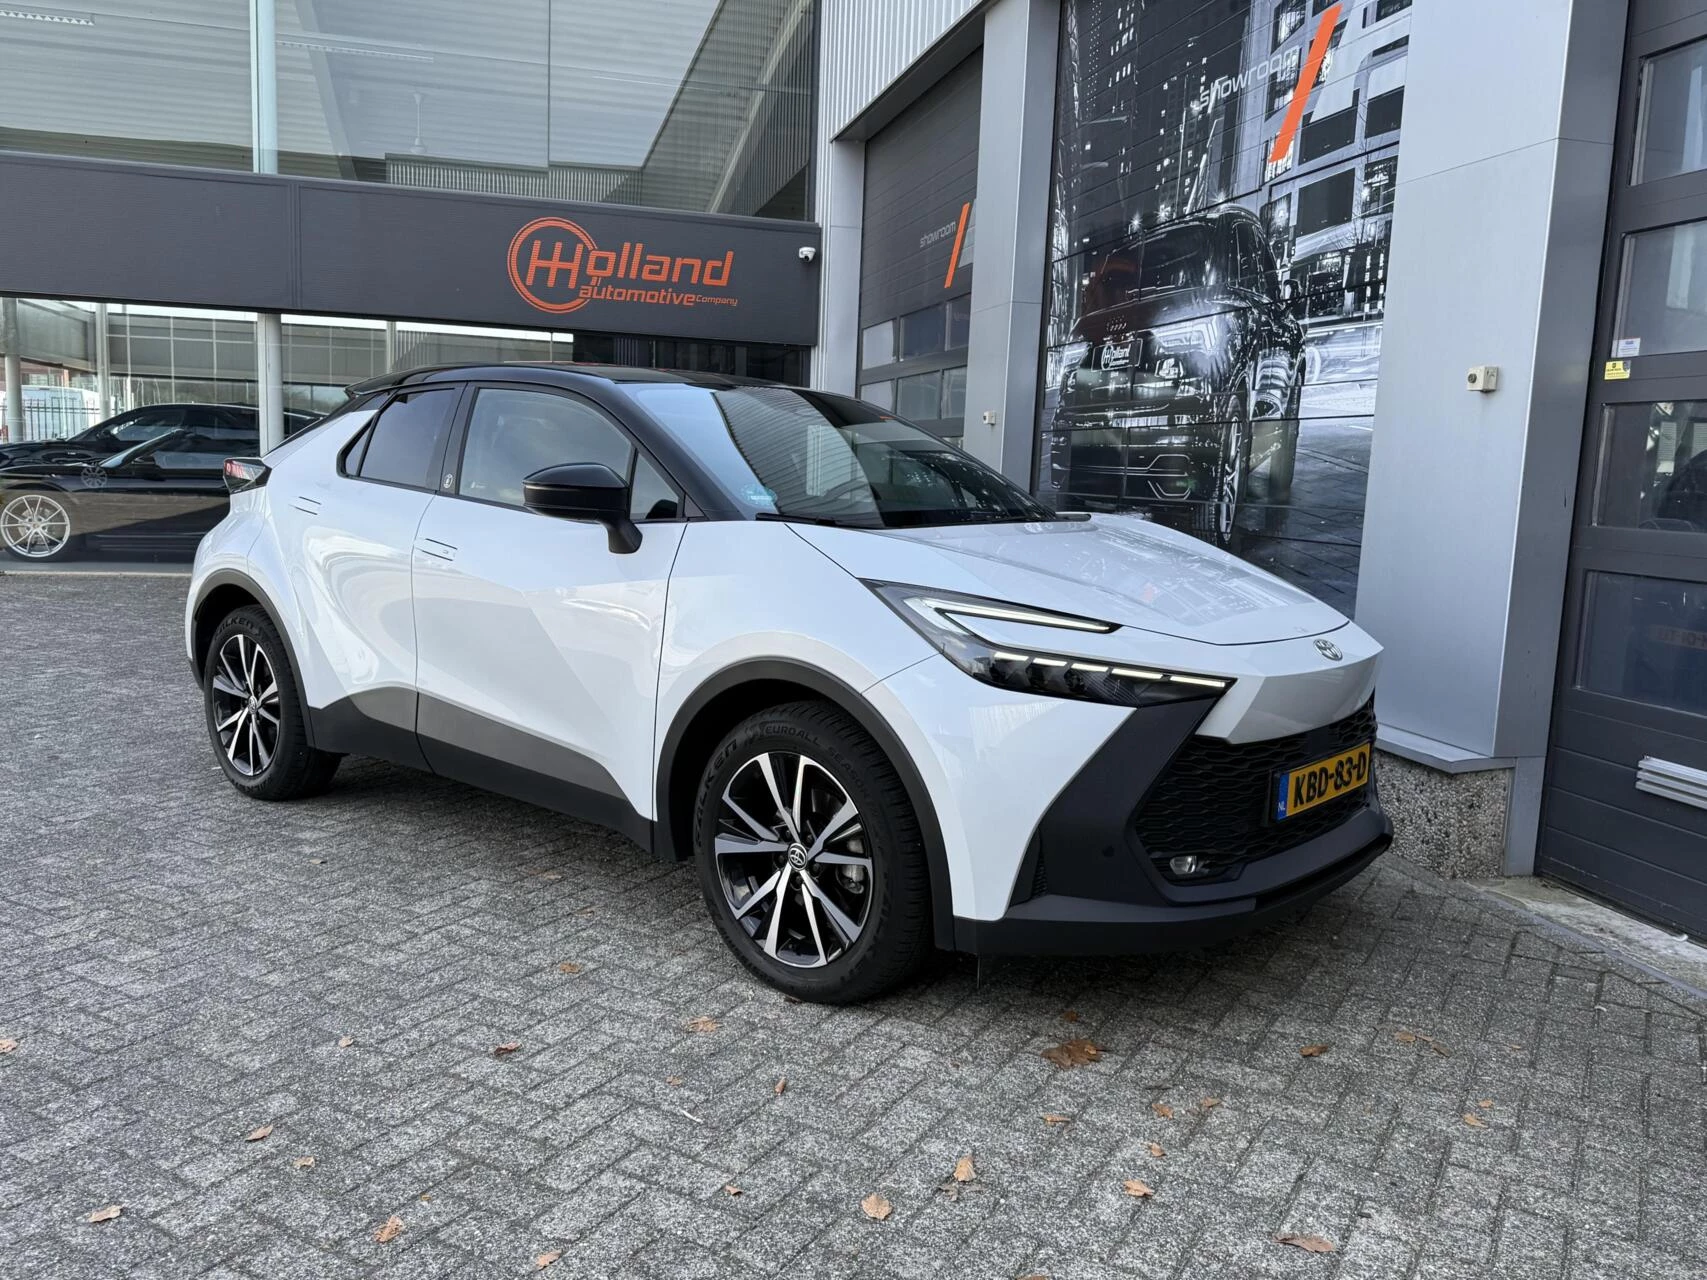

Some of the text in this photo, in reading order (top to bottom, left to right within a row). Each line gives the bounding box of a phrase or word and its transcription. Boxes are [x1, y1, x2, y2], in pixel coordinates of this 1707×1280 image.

[1200, 45, 1300, 109] showroom
[920, 221, 956, 248] showroom
[579, 284, 738, 307] automotive Company
[1293, 751, 1368, 808] KBD-83-D
[1278, 801, 1286, 812] NL
